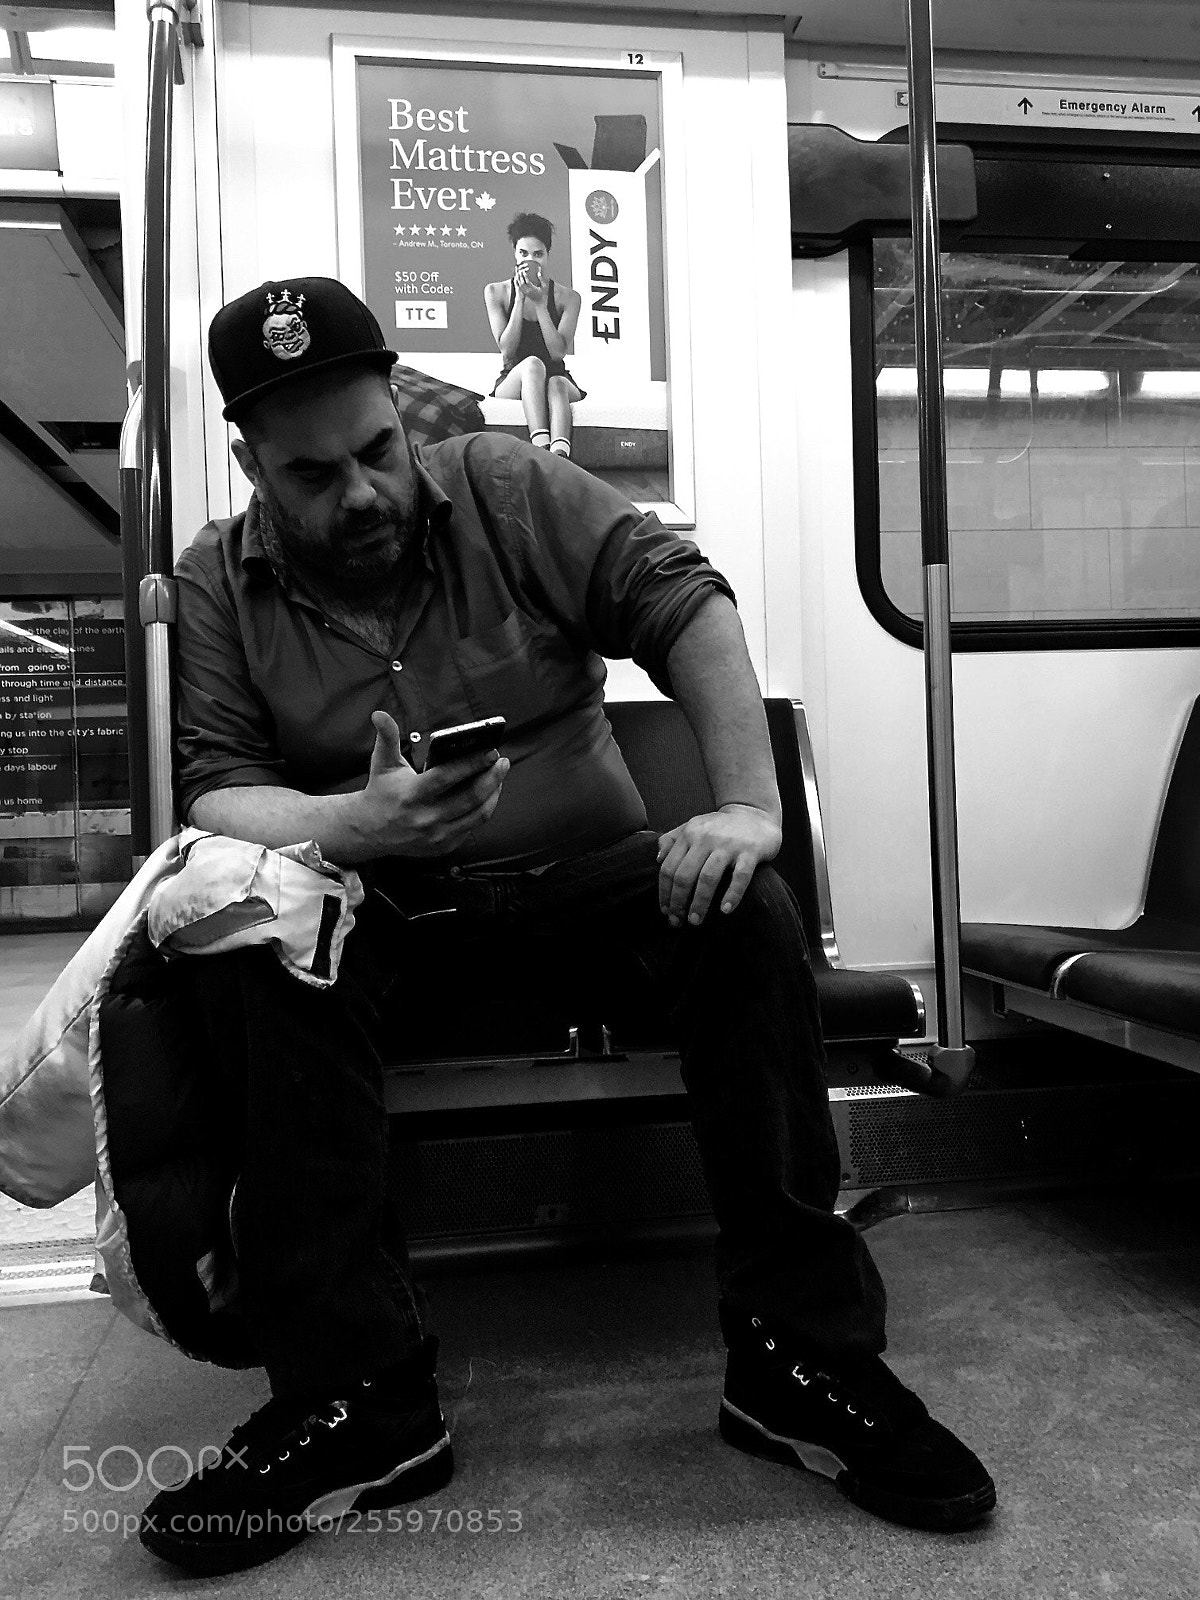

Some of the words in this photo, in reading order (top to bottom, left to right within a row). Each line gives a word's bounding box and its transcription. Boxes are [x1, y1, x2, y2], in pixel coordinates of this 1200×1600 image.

[627, 53, 645, 66] 12
[1059, 99, 1127, 115] Emergency
[1131, 102, 1166, 114] Alarm
[387, 98, 470, 133] Best
[388, 138, 546, 176] Mattress
[390, 178, 474, 212] Ever
[398, 239, 426, 248] Andrew
[440, 240, 470, 249] Toronto,
[470, 241, 484, 249] ON
[394, 271, 417, 283] $50
[419, 271, 440, 282] Off
[394, 283, 418, 294] with
[420, 283, 454, 294] Code:
[589, 228, 621, 345] ENDY
[405, 307, 436, 321] TTC
[35, 627, 51, 635] the
[74, 626, 83, 635] of
[84, 627, 100, 635] the
[101, 626, 125, 635] earth
[16, 645, 34, 654] and
[27, 663, 55, 673] going
[56, 663, 67, 671] to
[1, 680, 38, 689] through
[40, 679, 61, 687] time
[62, 678, 81, 687] and
[84, 678, 123, 687] distance
[13, 694, 30, 703] and
[32, 694, 54, 704] light
[15, 730, 26, 738] us
[28, 729, 47, 737] into
[48, 729, 65, 737] the
[67, 727, 95, 737] city's
[97, 727, 124, 736] fabric
[8, 747, 29, 755] stop
[3, 763, 26, 773] days
[27, 763, 58, 771] labour
[3, 798, 15, 806] us
[17, 797, 43, 805] home
